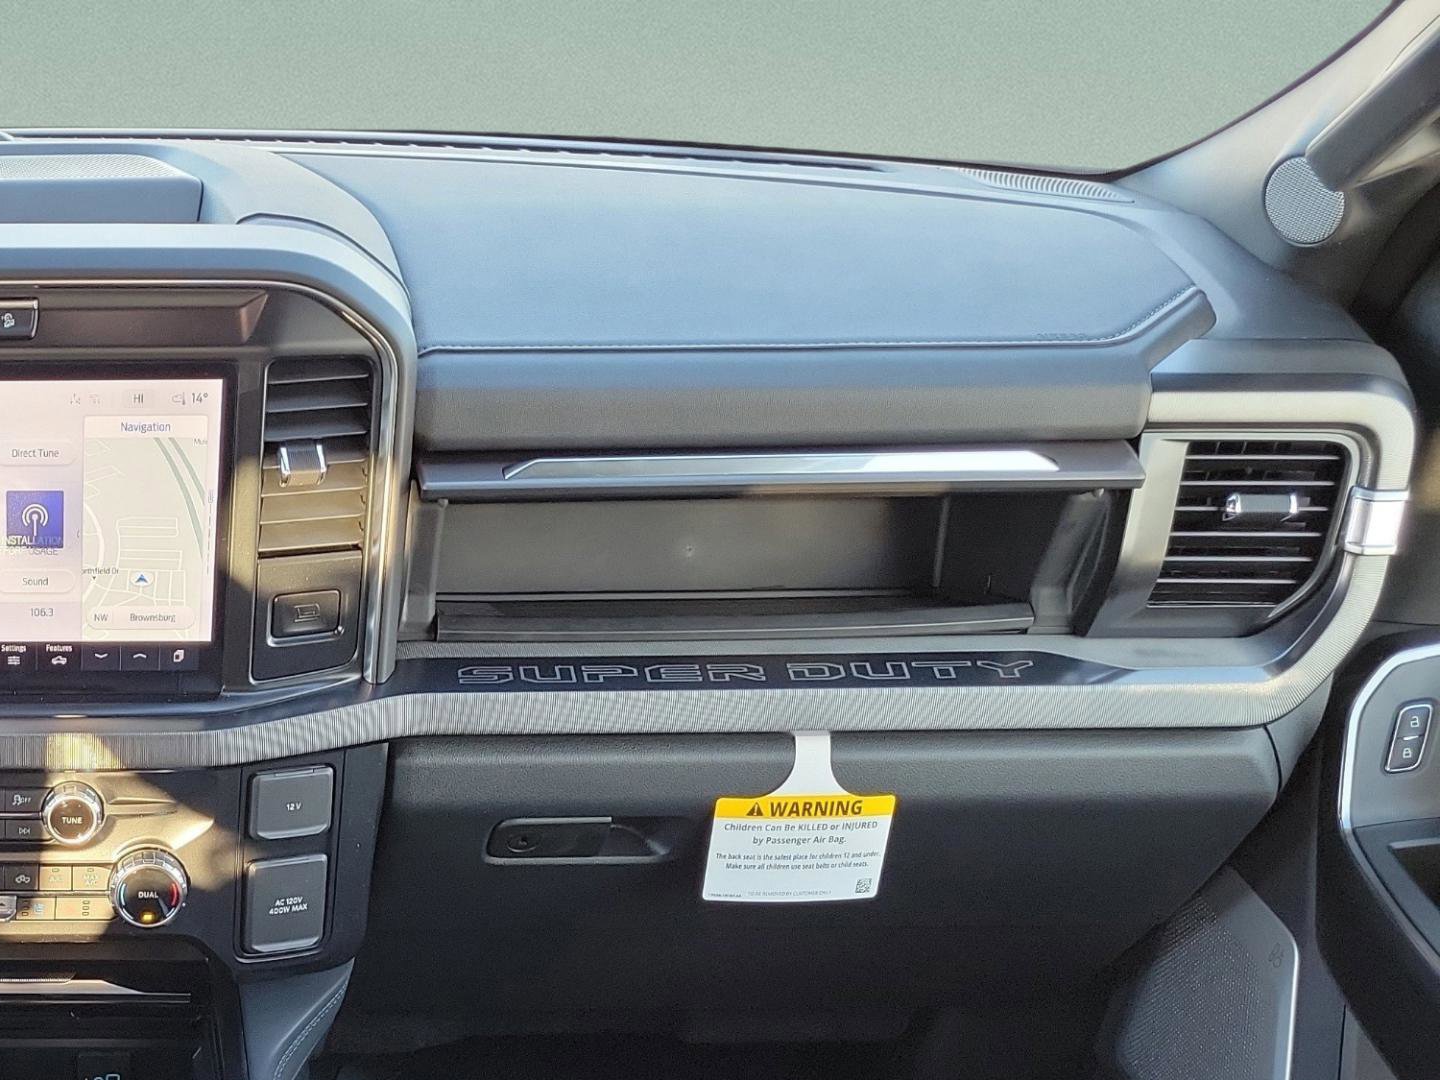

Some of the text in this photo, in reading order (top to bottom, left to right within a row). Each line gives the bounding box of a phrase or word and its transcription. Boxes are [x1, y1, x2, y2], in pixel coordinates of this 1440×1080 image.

[133, 393, 144, 404] HI
[120, 421, 171, 433] Navigation
[11, 448, 60, 459] Direct Tune
[22, 577, 49, 586] Sound
[30, 608, 54, 617] 106.3
[94, 613, 109, 622] NW
[129, 613, 176, 624] Brownsburg
[0, 643, 27, 653] Settings
[45, 643, 73, 653] Features
[457, 659, 1034, 686] SUPER DUTY
[286, 802, 302, 811] 12 V
[770, 800, 863, 818] WARNING
[61, 816, 83, 825] TUNE
[724, 823, 763, 832] Children
[764, 824, 782, 832] Can
[784, 824, 796, 832] Be
[797, 823, 828, 831] KILLED
[841, 820, 878, 831] INJURED
[752, 835, 847, 846] by Passenger Air Bag.
[716, 852, 726, 860] The
[792, 853, 808, 861] place
[819, 852, 842, 860] children
[815, 862, 830, 870] belts
[137, 891, 159, 899] DUAL
[286, 896, 303, 905] 120V
[268, 903, 308, 915] 400W MAX
